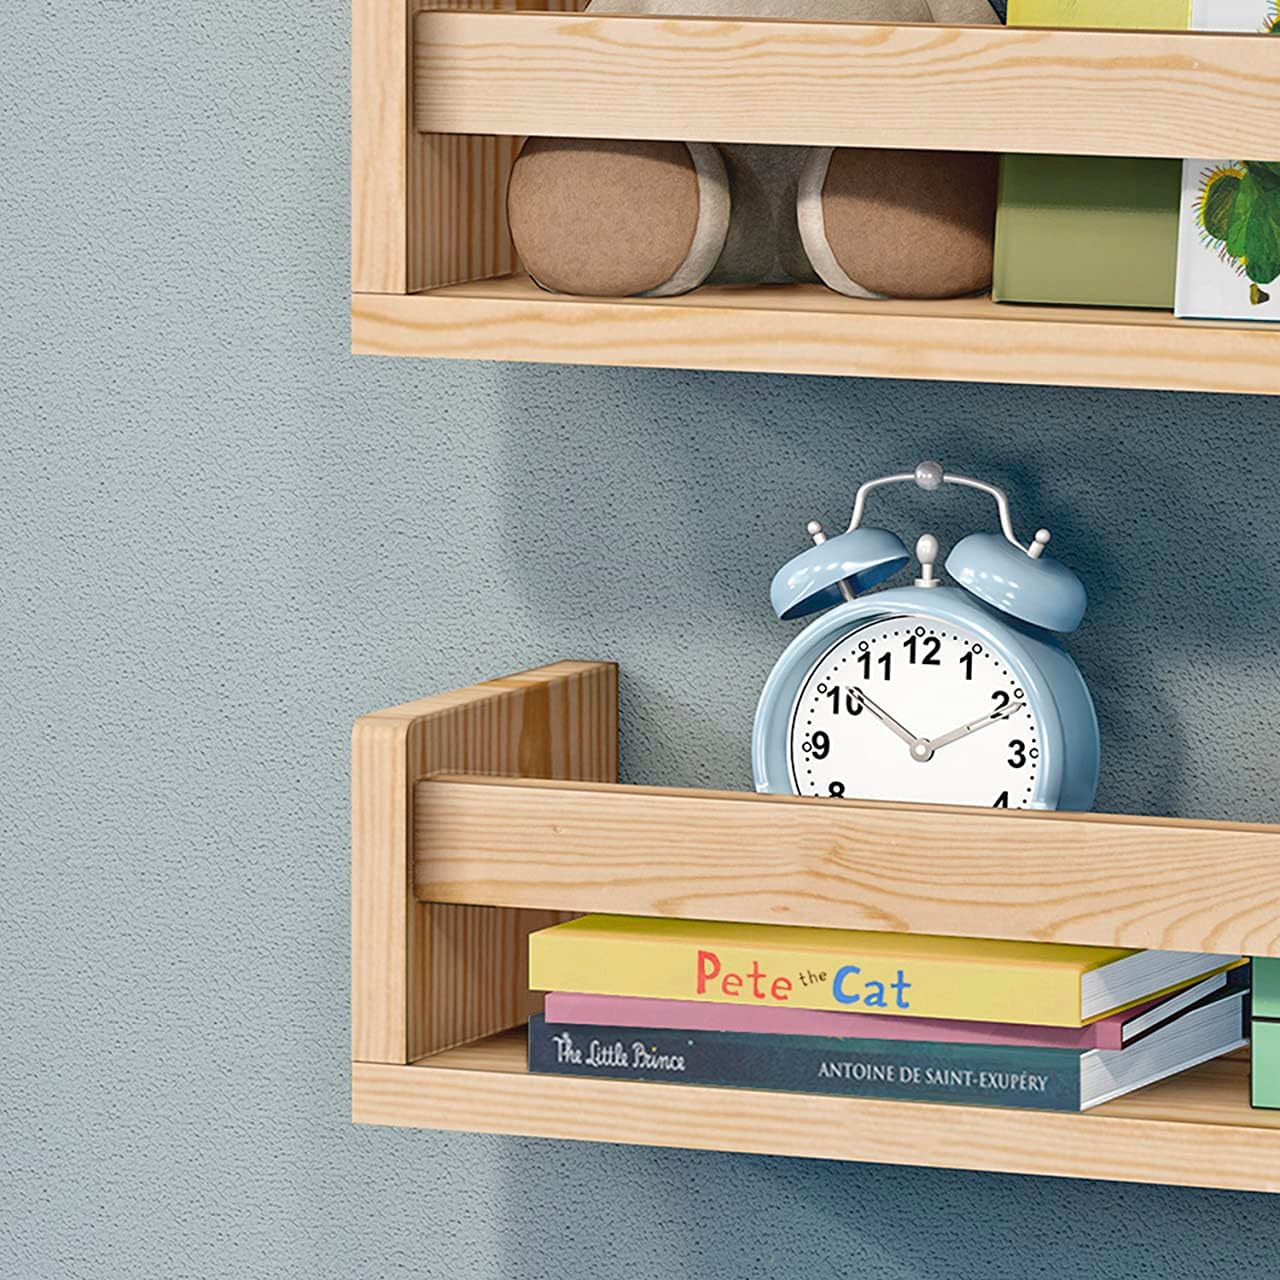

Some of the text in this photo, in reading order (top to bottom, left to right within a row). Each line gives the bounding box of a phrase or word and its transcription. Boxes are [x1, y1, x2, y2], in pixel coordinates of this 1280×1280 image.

[903, 635, 941, 665] 12
[857, 651, 892, 681] 11
[959, 651, 973, 681] 1
[827, 685, 864, 716] 10
[990, 690, 1010, 720] 2
[812, 730, 830, 760] 9
[1007, 739, 1027, 769] 3
[696, 949, 912, 1009] Pete the Cat
[552, 1032, 1049, 1092] The Little Prince ANTOINE DE SAINT-EXUPÉRY
